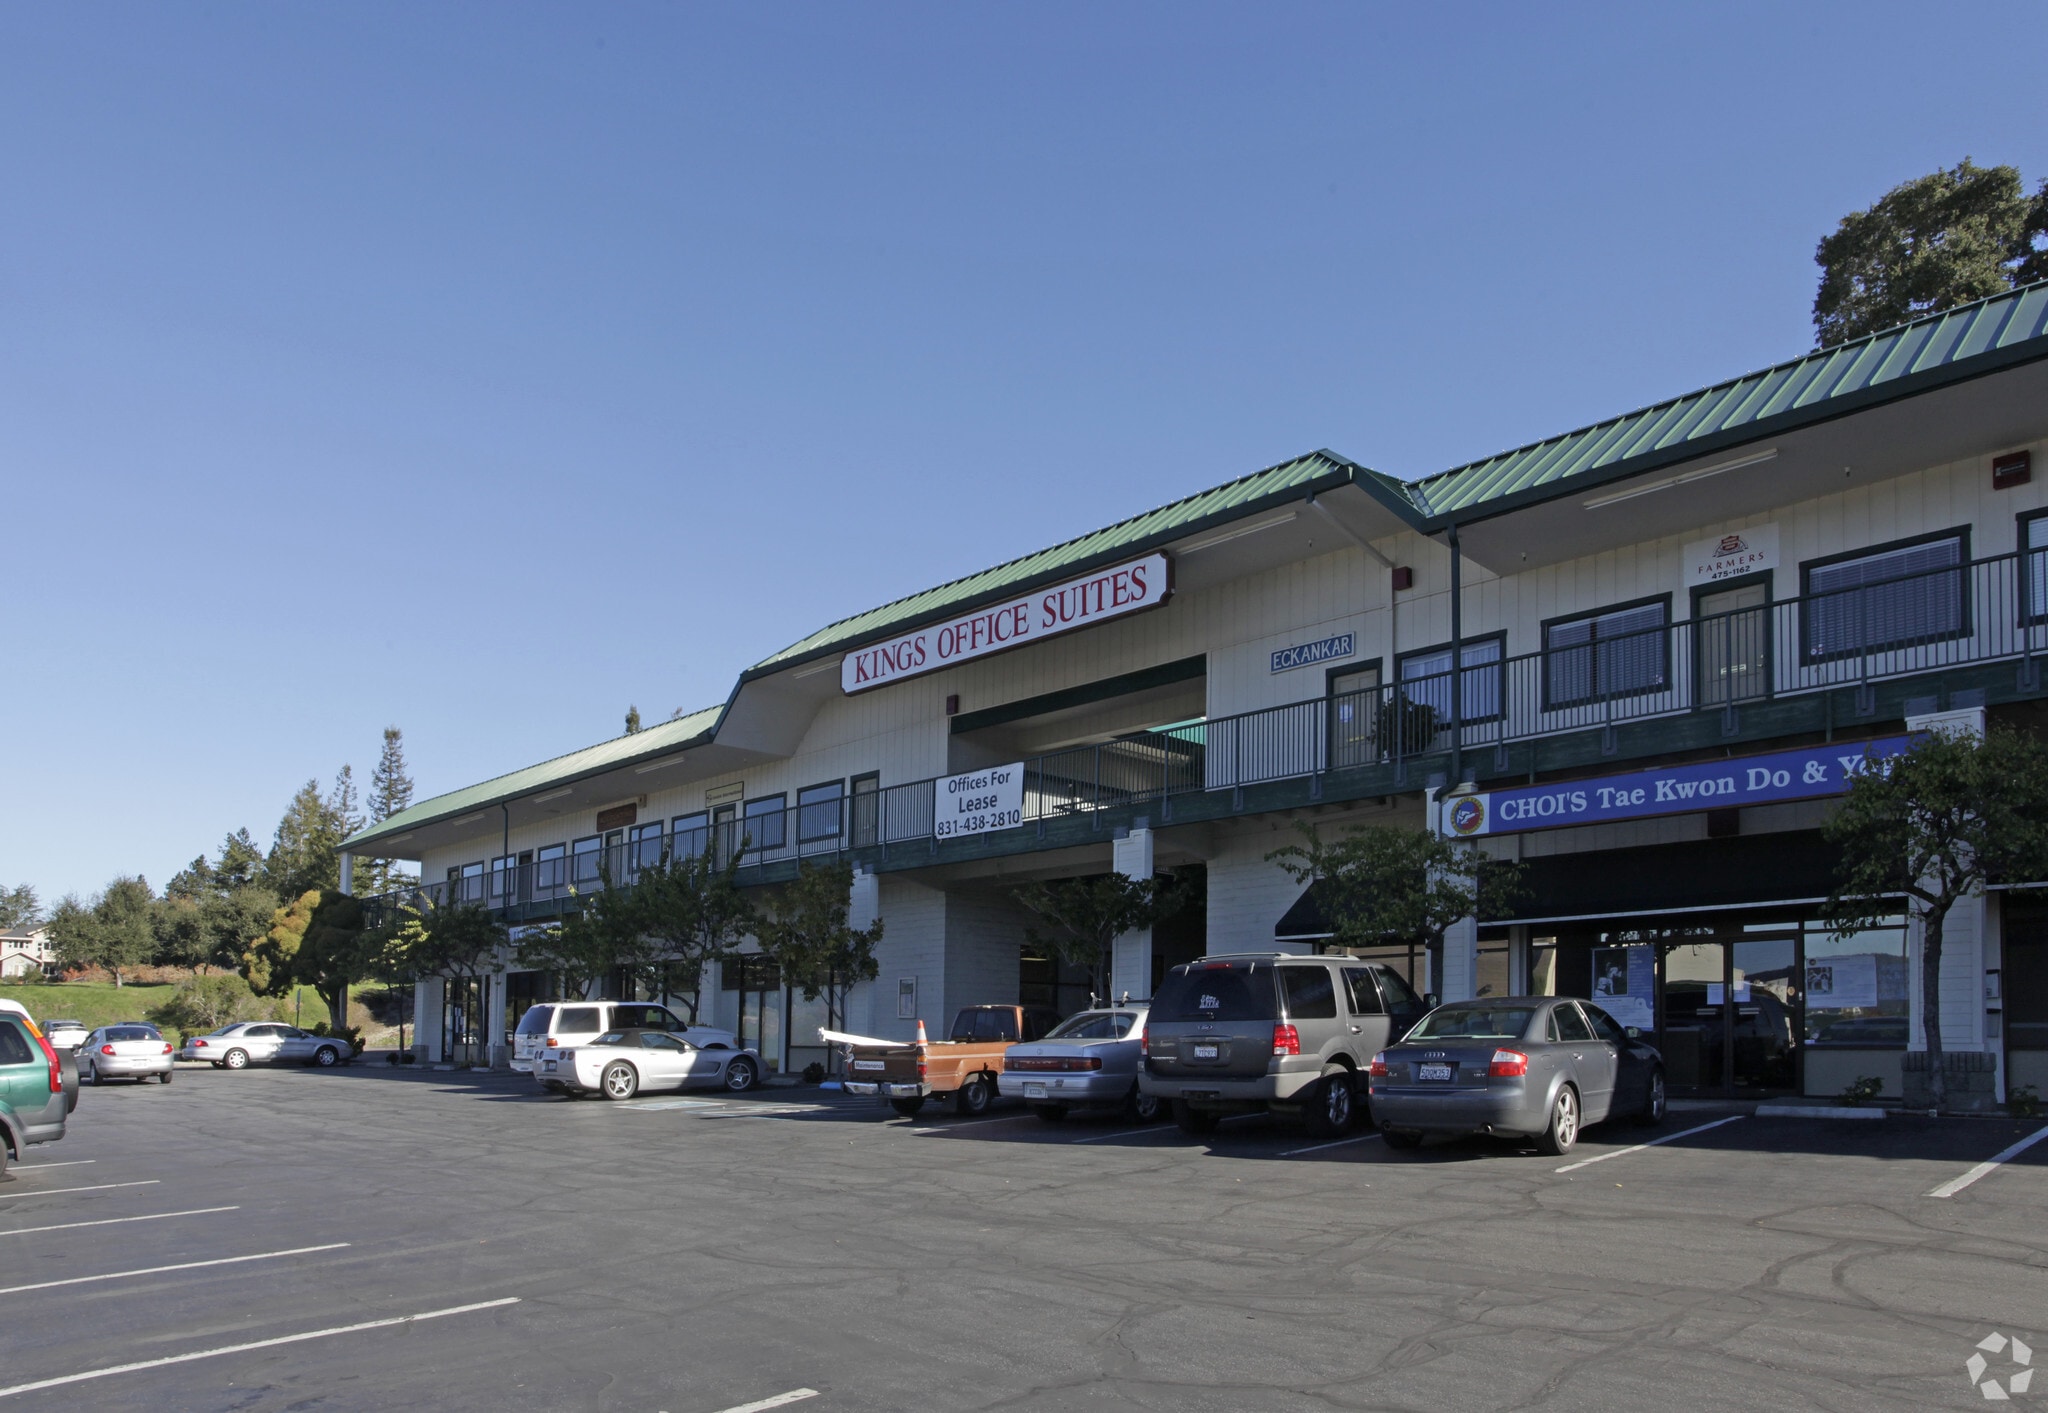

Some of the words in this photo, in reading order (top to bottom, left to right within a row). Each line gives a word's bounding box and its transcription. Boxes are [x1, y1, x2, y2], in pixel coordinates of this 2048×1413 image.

[1698, 551, 1764, 574] FARMERS
[1711, 565, 1751, 579] 475-1162
[854, 635, 926, 684] KINGS
[937, 602, 1030, 659] OFFICE
[1042, 565, 1147, 630] SUITES
[1273, 636, 1350, 670] ECKANKAR
[948, 776, 988, 794] Offices
[991, 771, 1011, 786] For
[1500, 790, 1588, 821] CHOI'S
[1596, 787, 1646, 808] Tae
[1655, 777, 1735, 801] Kwon
[1746, 767, 1791, 791] Do
[1802, 760, 1828, 784] &
[958, 795, 998, 814] Lease
[937, 809, 1020, 836] 831-438-2810
